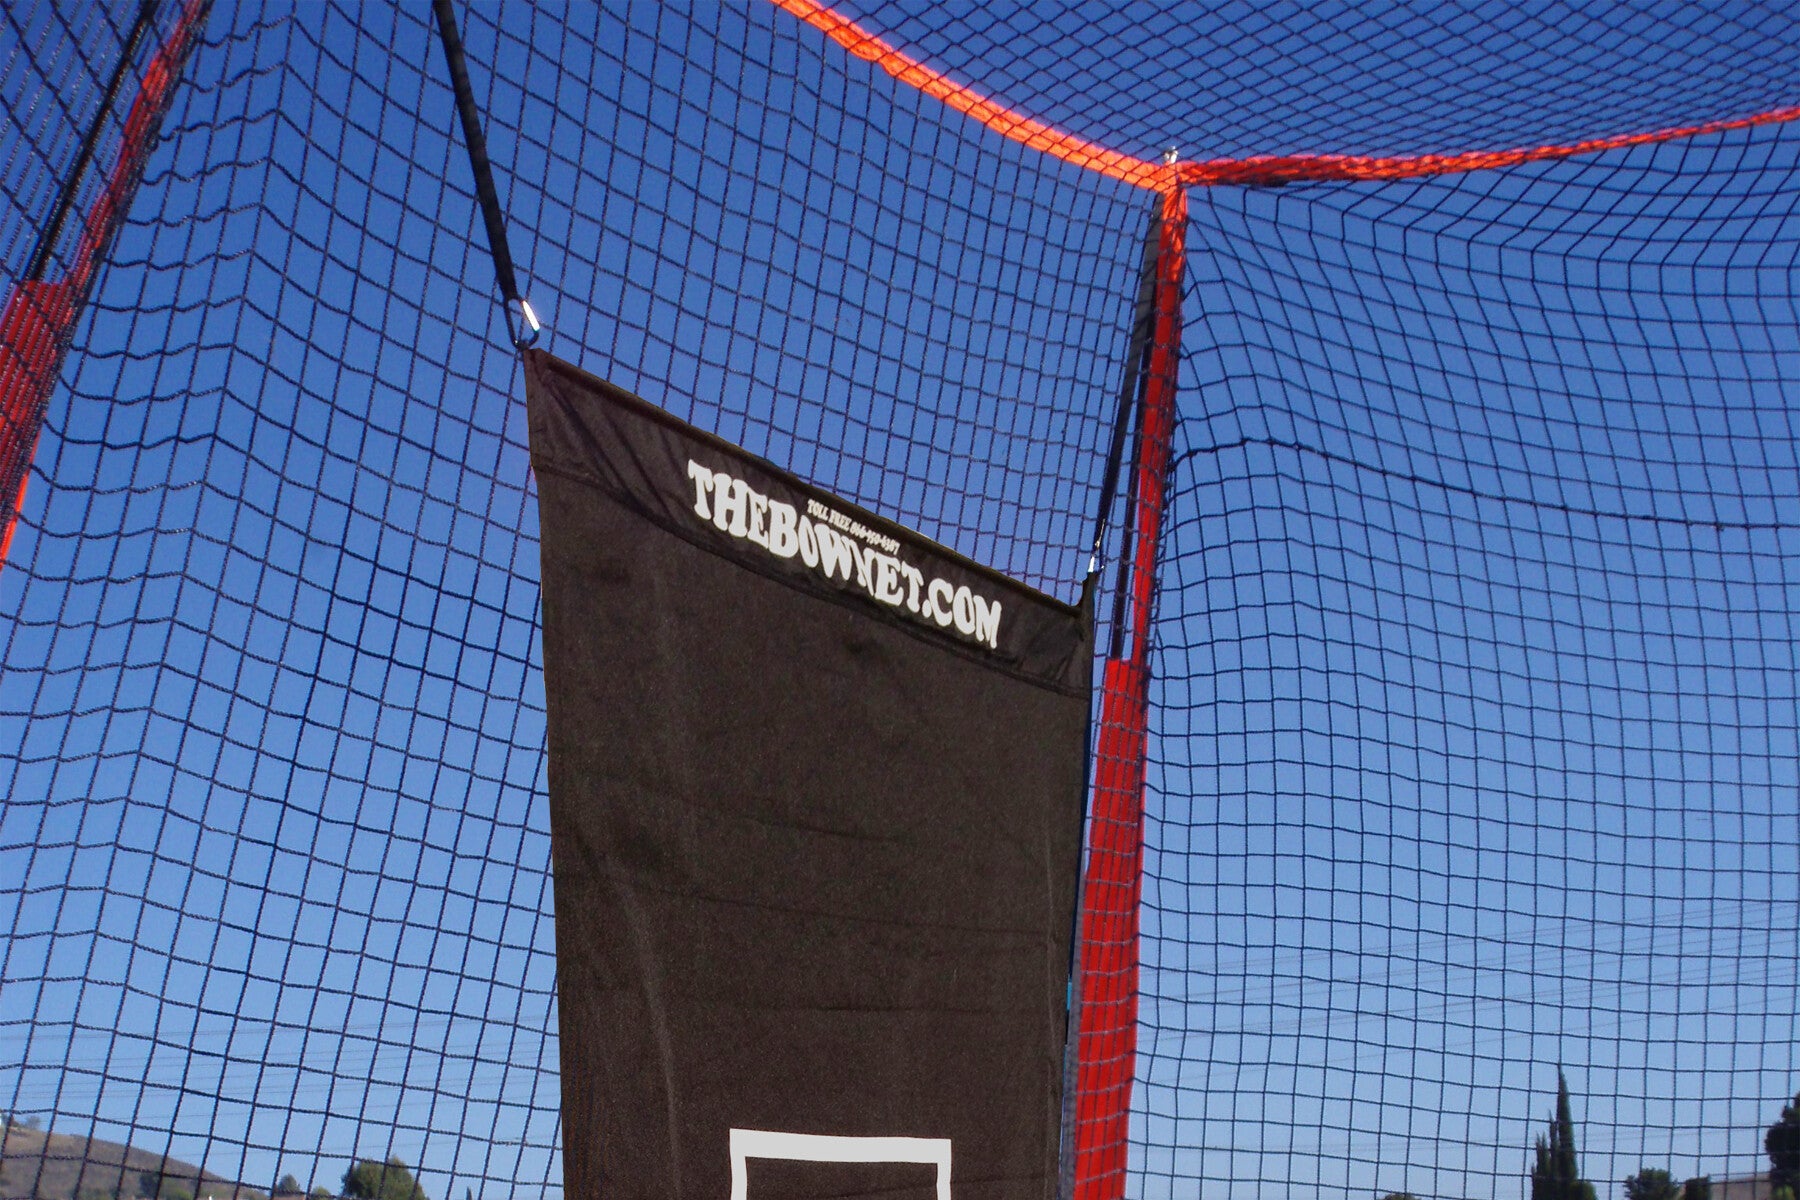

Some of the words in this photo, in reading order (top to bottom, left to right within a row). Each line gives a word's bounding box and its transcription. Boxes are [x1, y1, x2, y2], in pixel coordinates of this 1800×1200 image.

[687, 458, 1002, 649] THEBOWNET.COM
[807, 498, 829, 521] TOLL
[828, 509, 852, 532] FREE
